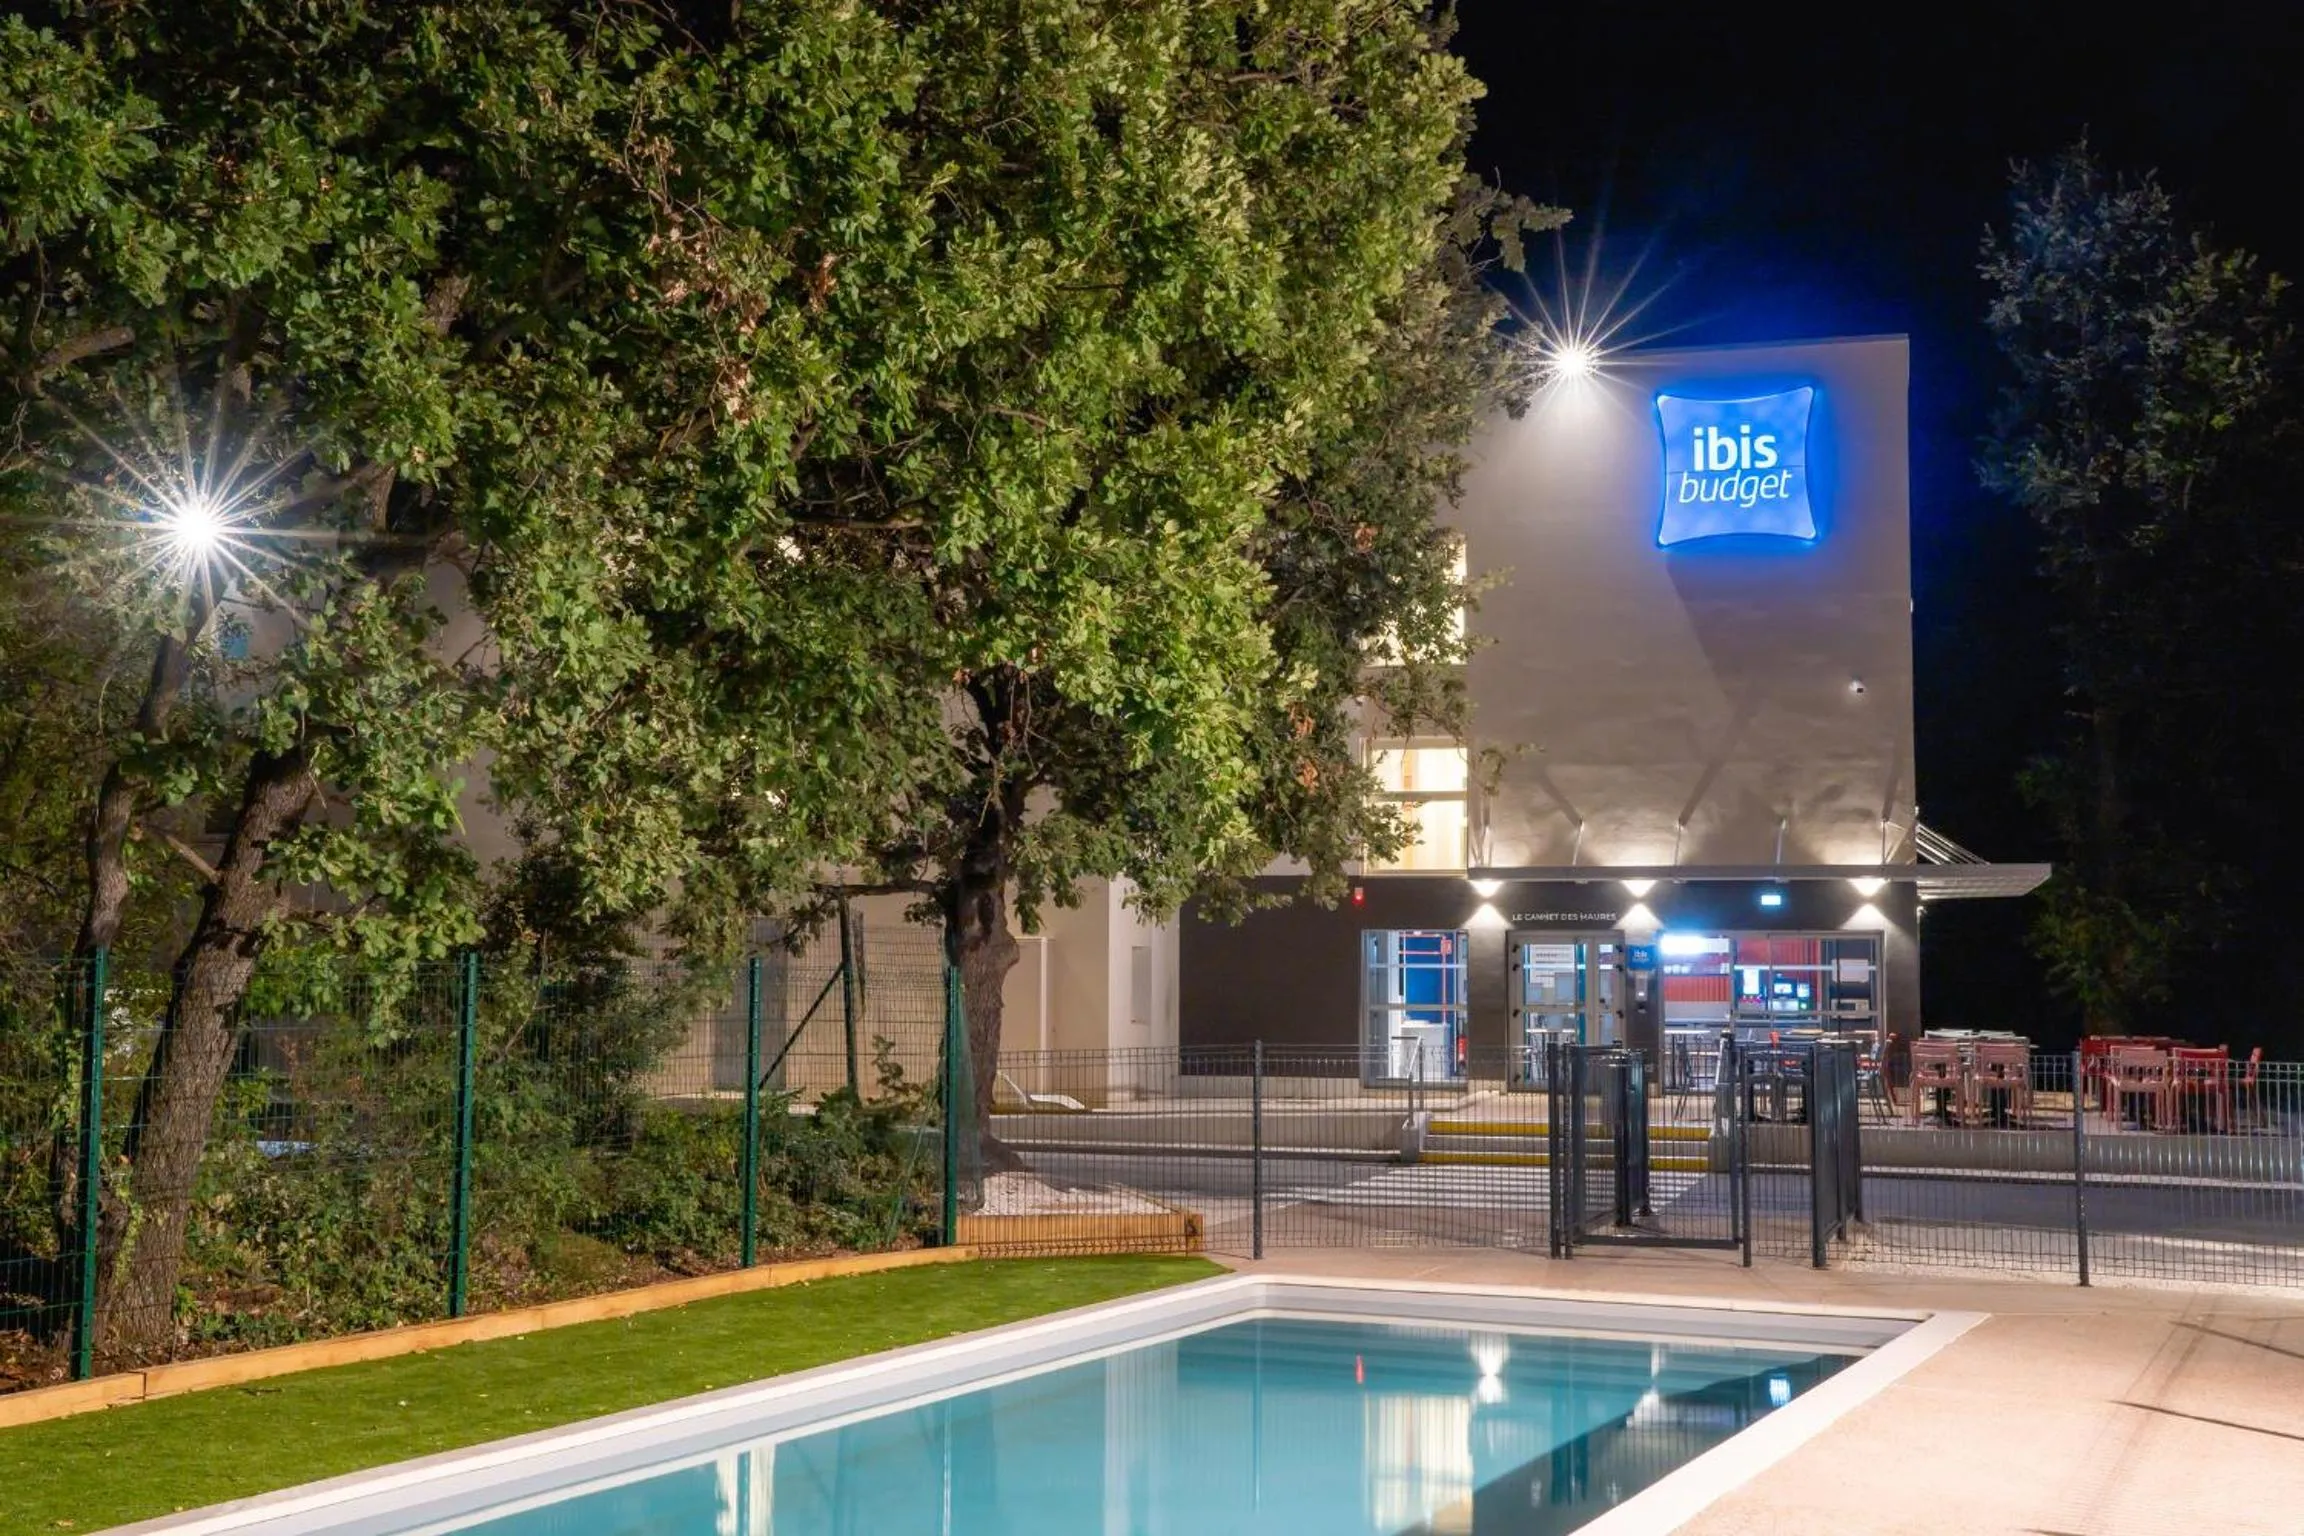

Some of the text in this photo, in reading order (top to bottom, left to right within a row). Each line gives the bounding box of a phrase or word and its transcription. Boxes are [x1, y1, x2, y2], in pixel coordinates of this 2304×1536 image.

[1693, 425, 1779, 471] ibis
[1680, 469, 1792, 509] budget
[1512, 912, 1523, 921] LE
[1561, 912, 1578, 921] DES
[1580, 912, 1617, 921] MAURES
